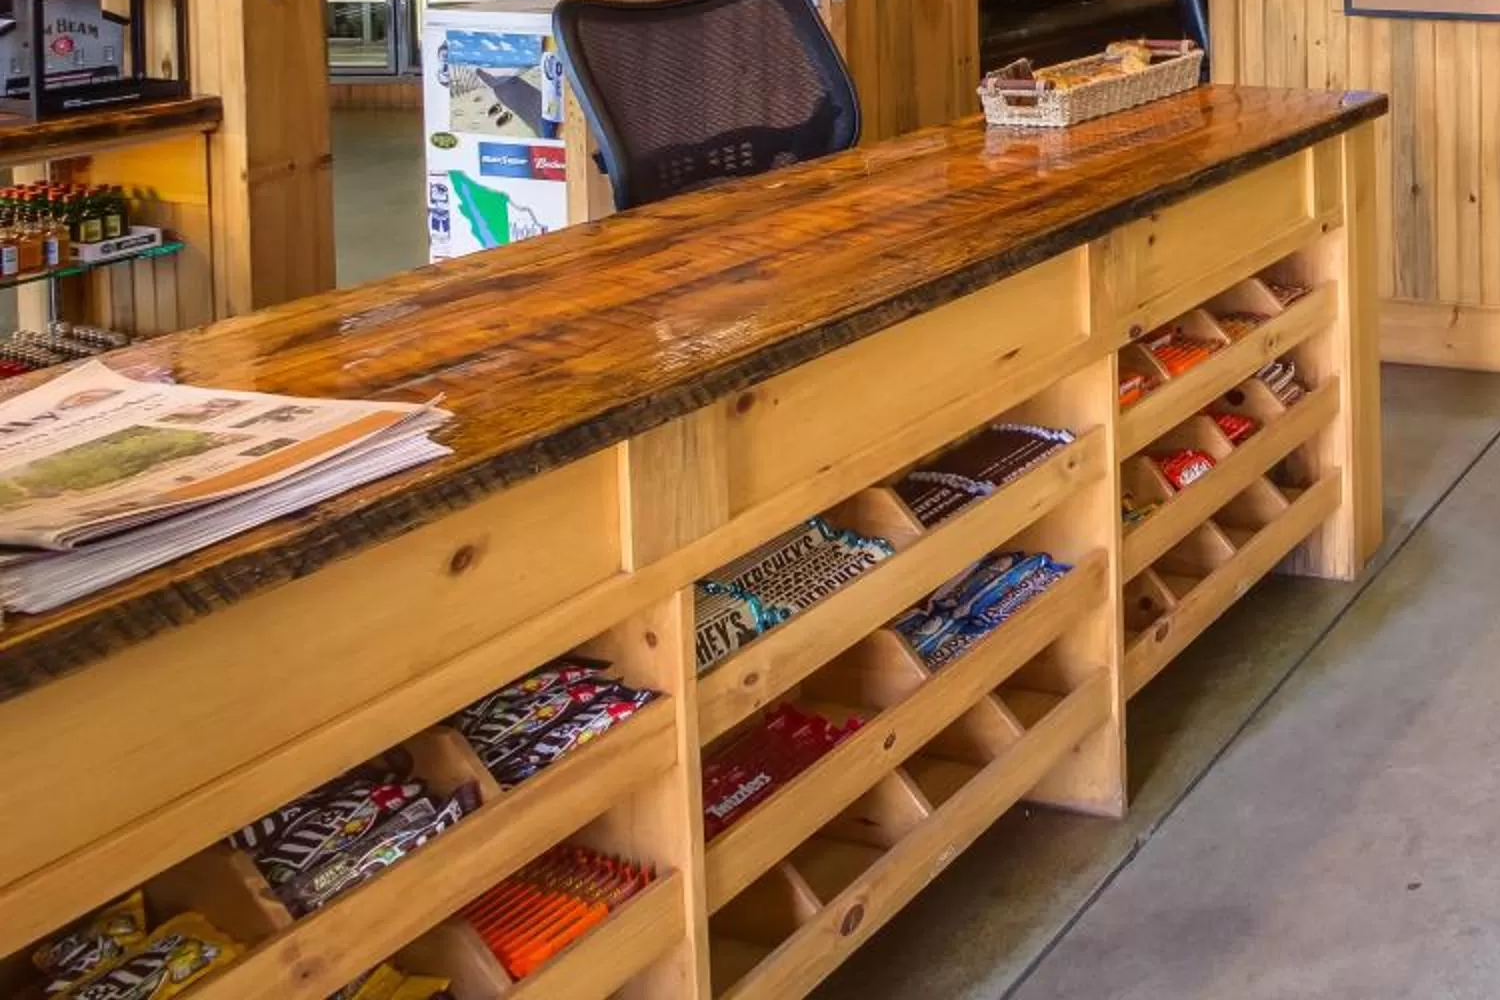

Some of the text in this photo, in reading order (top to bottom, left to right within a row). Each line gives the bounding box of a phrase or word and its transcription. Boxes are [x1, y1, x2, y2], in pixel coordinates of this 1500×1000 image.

[56, 17, 100, 38] BEAM
[696, 608, 748, 668] HEY'S
[705, 771, 773, 818] Twizzlers
